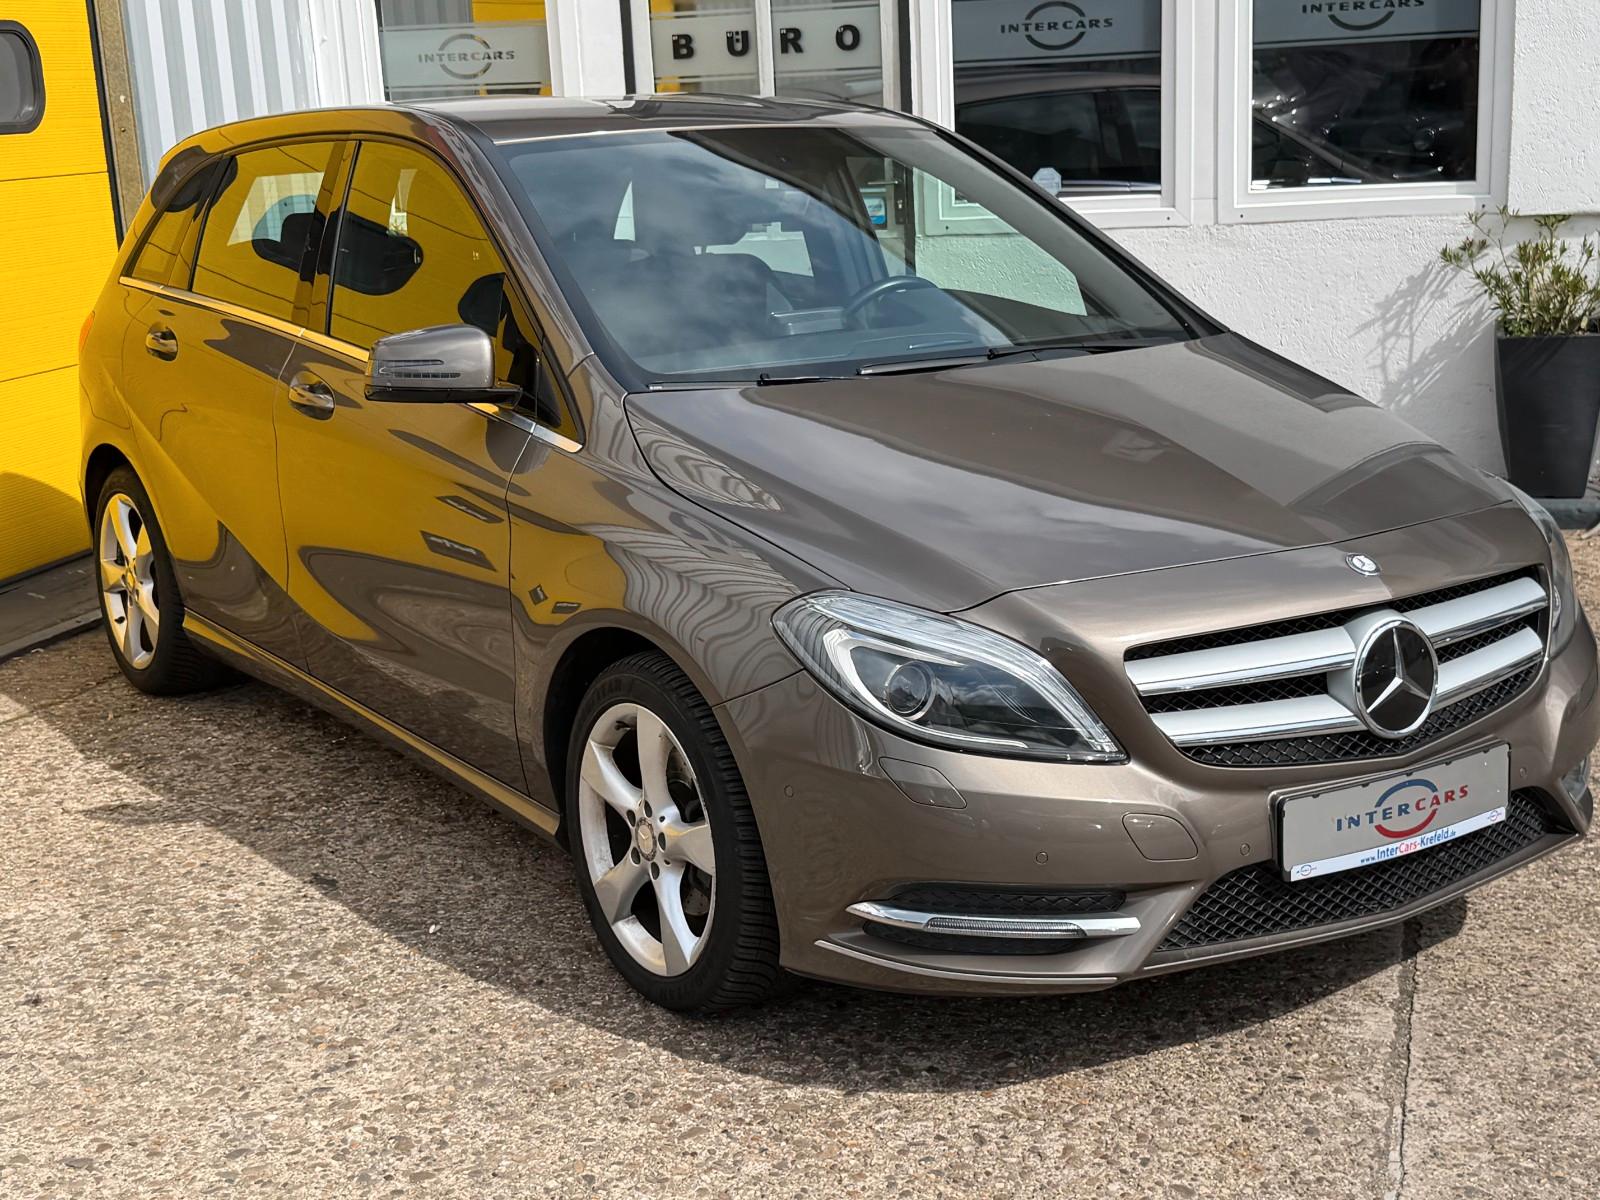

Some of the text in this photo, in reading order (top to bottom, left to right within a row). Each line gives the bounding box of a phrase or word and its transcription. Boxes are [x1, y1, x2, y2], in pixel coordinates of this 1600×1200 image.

[671, 24, 860, 60] BÜRO
[1000, 17, 1113, 34] INTERCARS
[418, 50, 515, 63] INTERCARS
[1336, 785, 1469, 831] INTERCARS
[1360, 828, 1457, 864] www.InterCars-Krefeld.de
